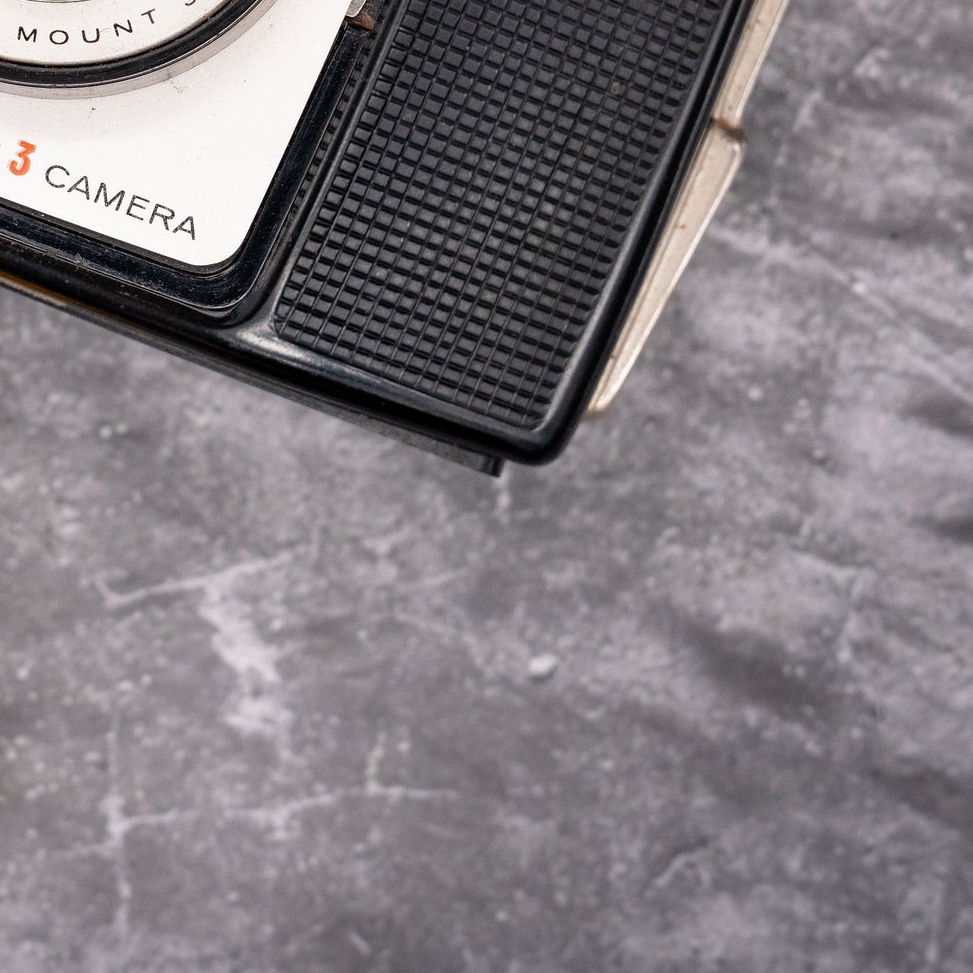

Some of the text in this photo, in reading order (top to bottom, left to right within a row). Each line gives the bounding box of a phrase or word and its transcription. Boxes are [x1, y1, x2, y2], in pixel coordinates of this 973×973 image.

[16, 8, 157, 46] MOUNT
[7, 138, 38, 178] 3
[44, 164, 198, 242] CAMERA
